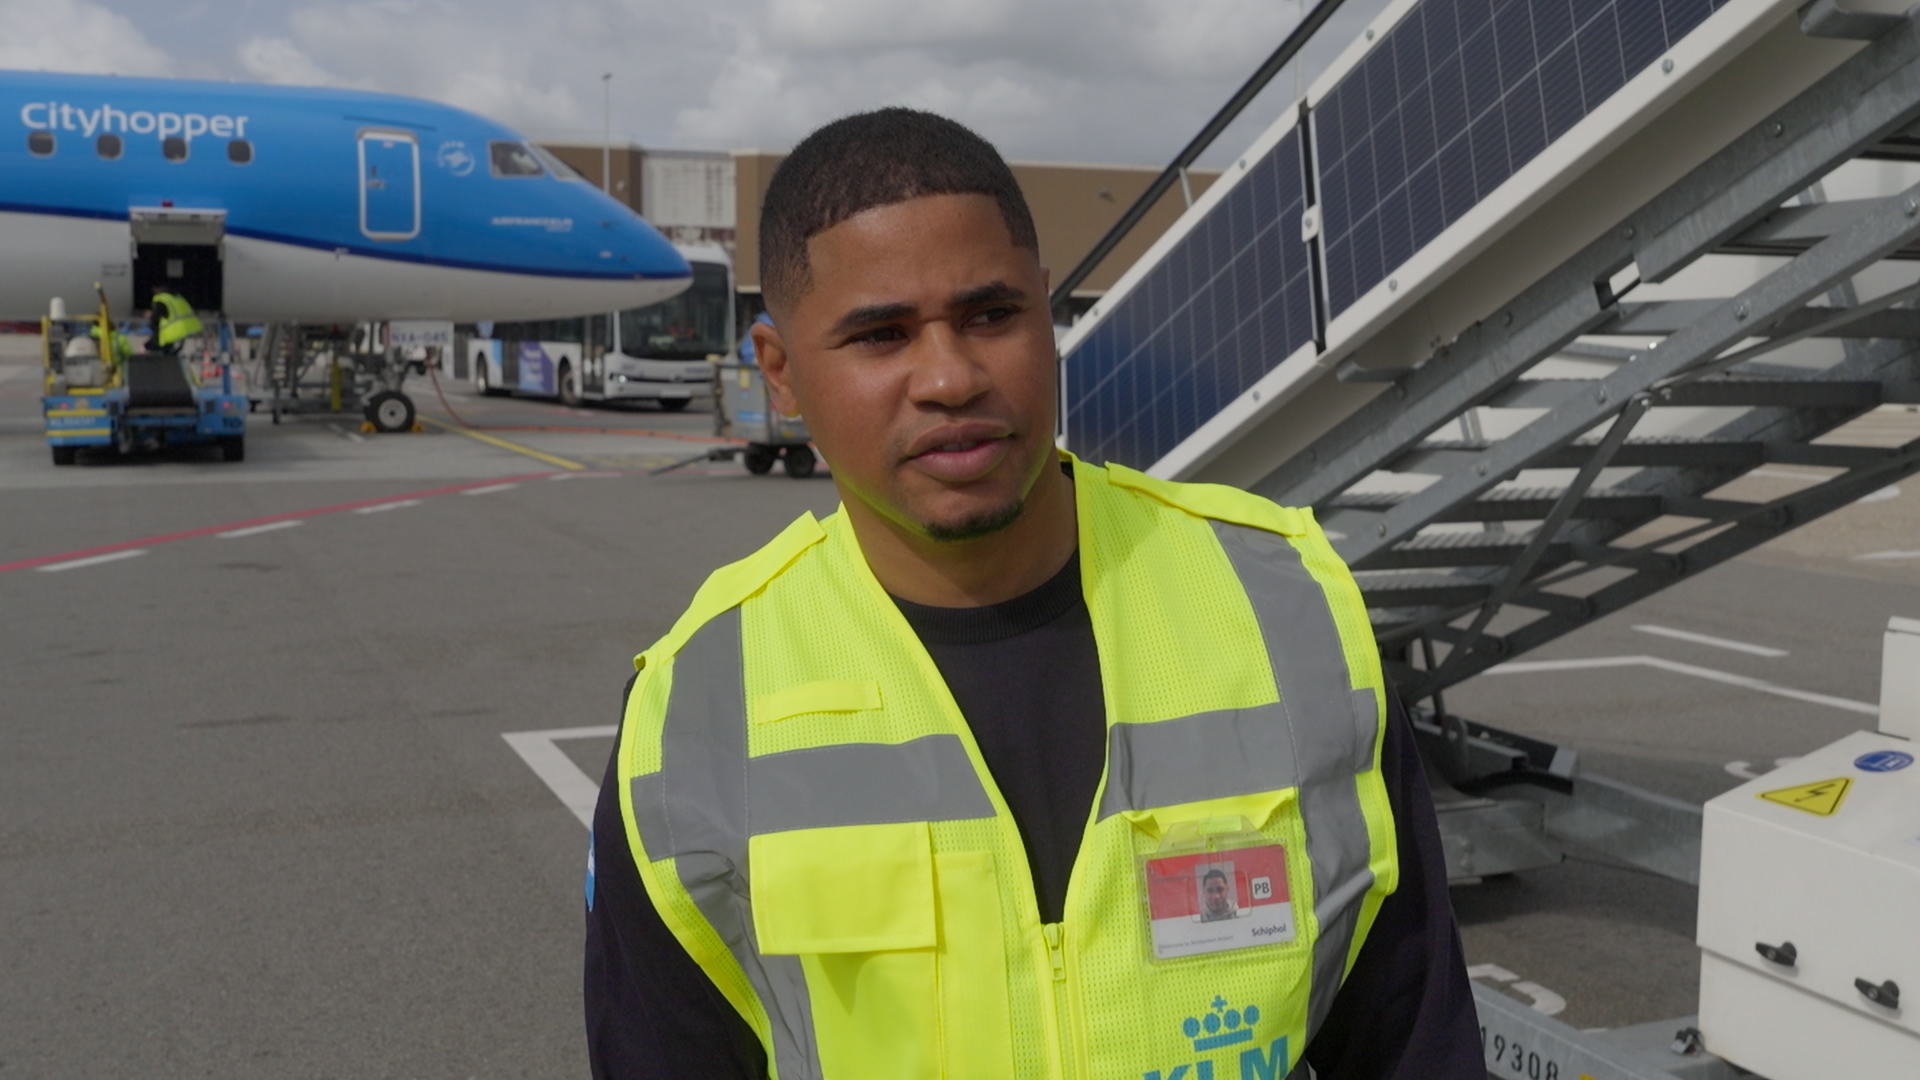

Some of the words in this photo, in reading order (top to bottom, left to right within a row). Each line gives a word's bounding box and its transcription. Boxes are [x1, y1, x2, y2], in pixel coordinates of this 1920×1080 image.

[20, 101, 249, 141] Cityhopper
[1254, 881, 1270, 895] PB
[1251, 923, 1287, 937] Schiphol
